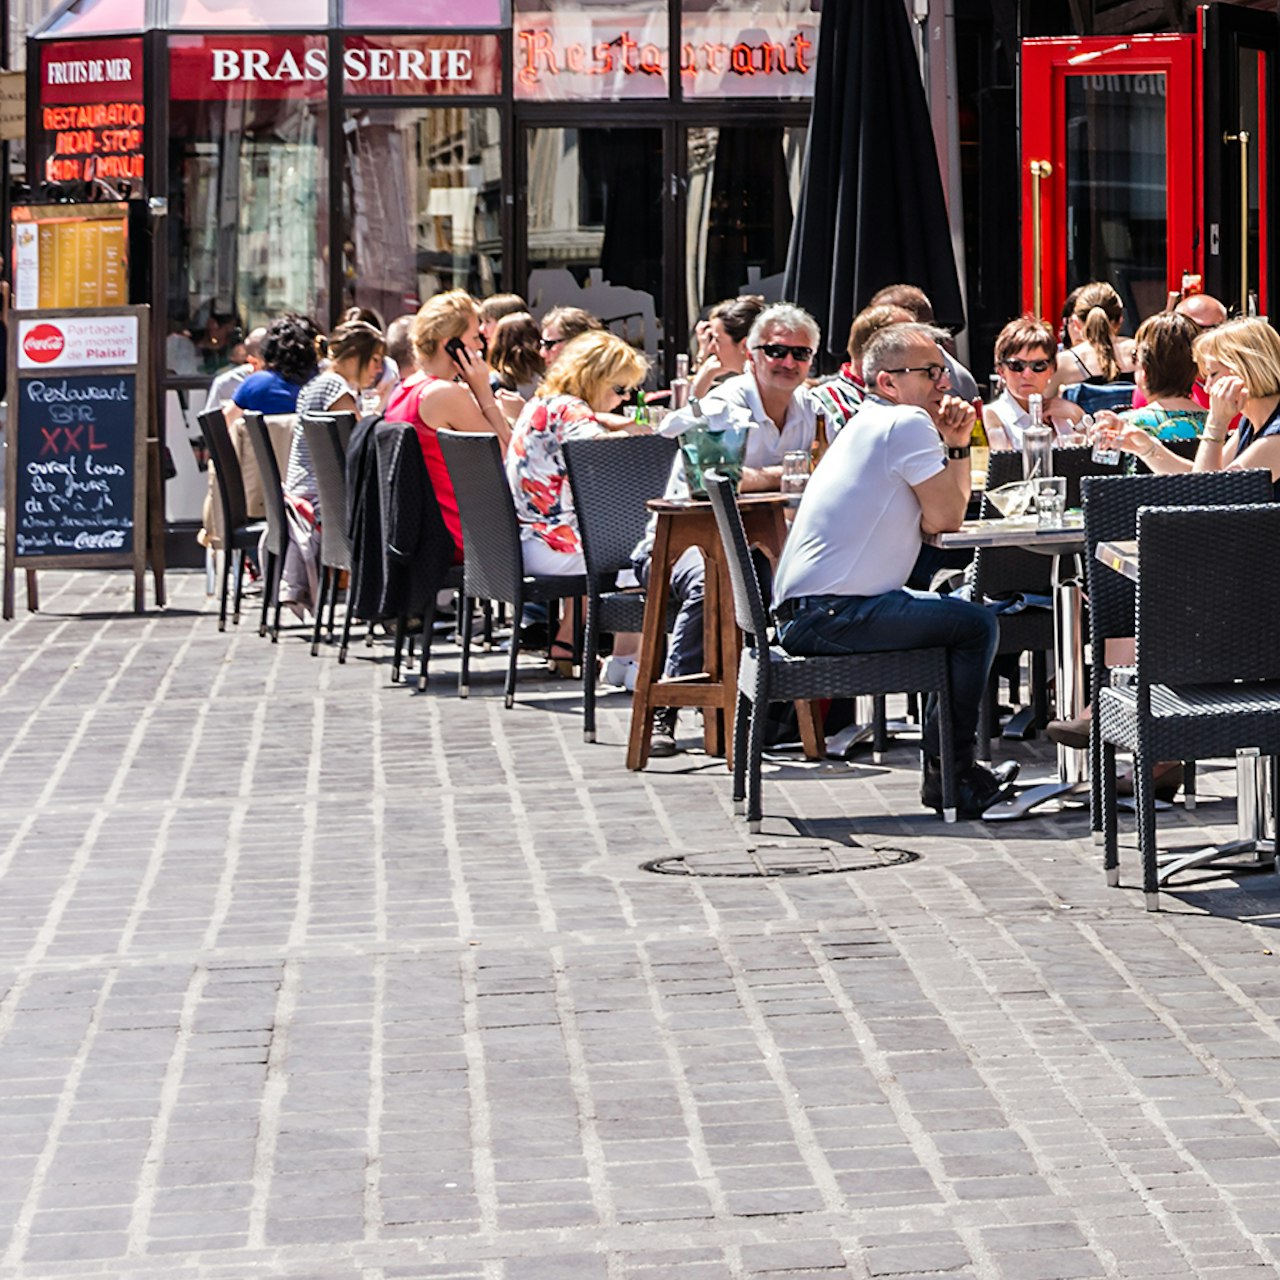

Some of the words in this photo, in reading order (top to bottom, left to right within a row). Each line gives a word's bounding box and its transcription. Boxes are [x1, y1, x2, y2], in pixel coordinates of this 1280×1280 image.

[47, 61, 87, 84] FRUITS
[89, 60, 105, 82] DE
[106, 58, 132, 81] MER
[211, 49, 473, 81] BRASSERIE
[67, 324, 126, 336] Partagez
[86, 337, 133, 346] moment
[67, 350, 82, 360] de
[86, 349, 127, 359] Plaisir
[27, 380, 129, 402] Restaurant
[48, 404, 96, 424] BAR
[40, 424, 108, 456] XXL
